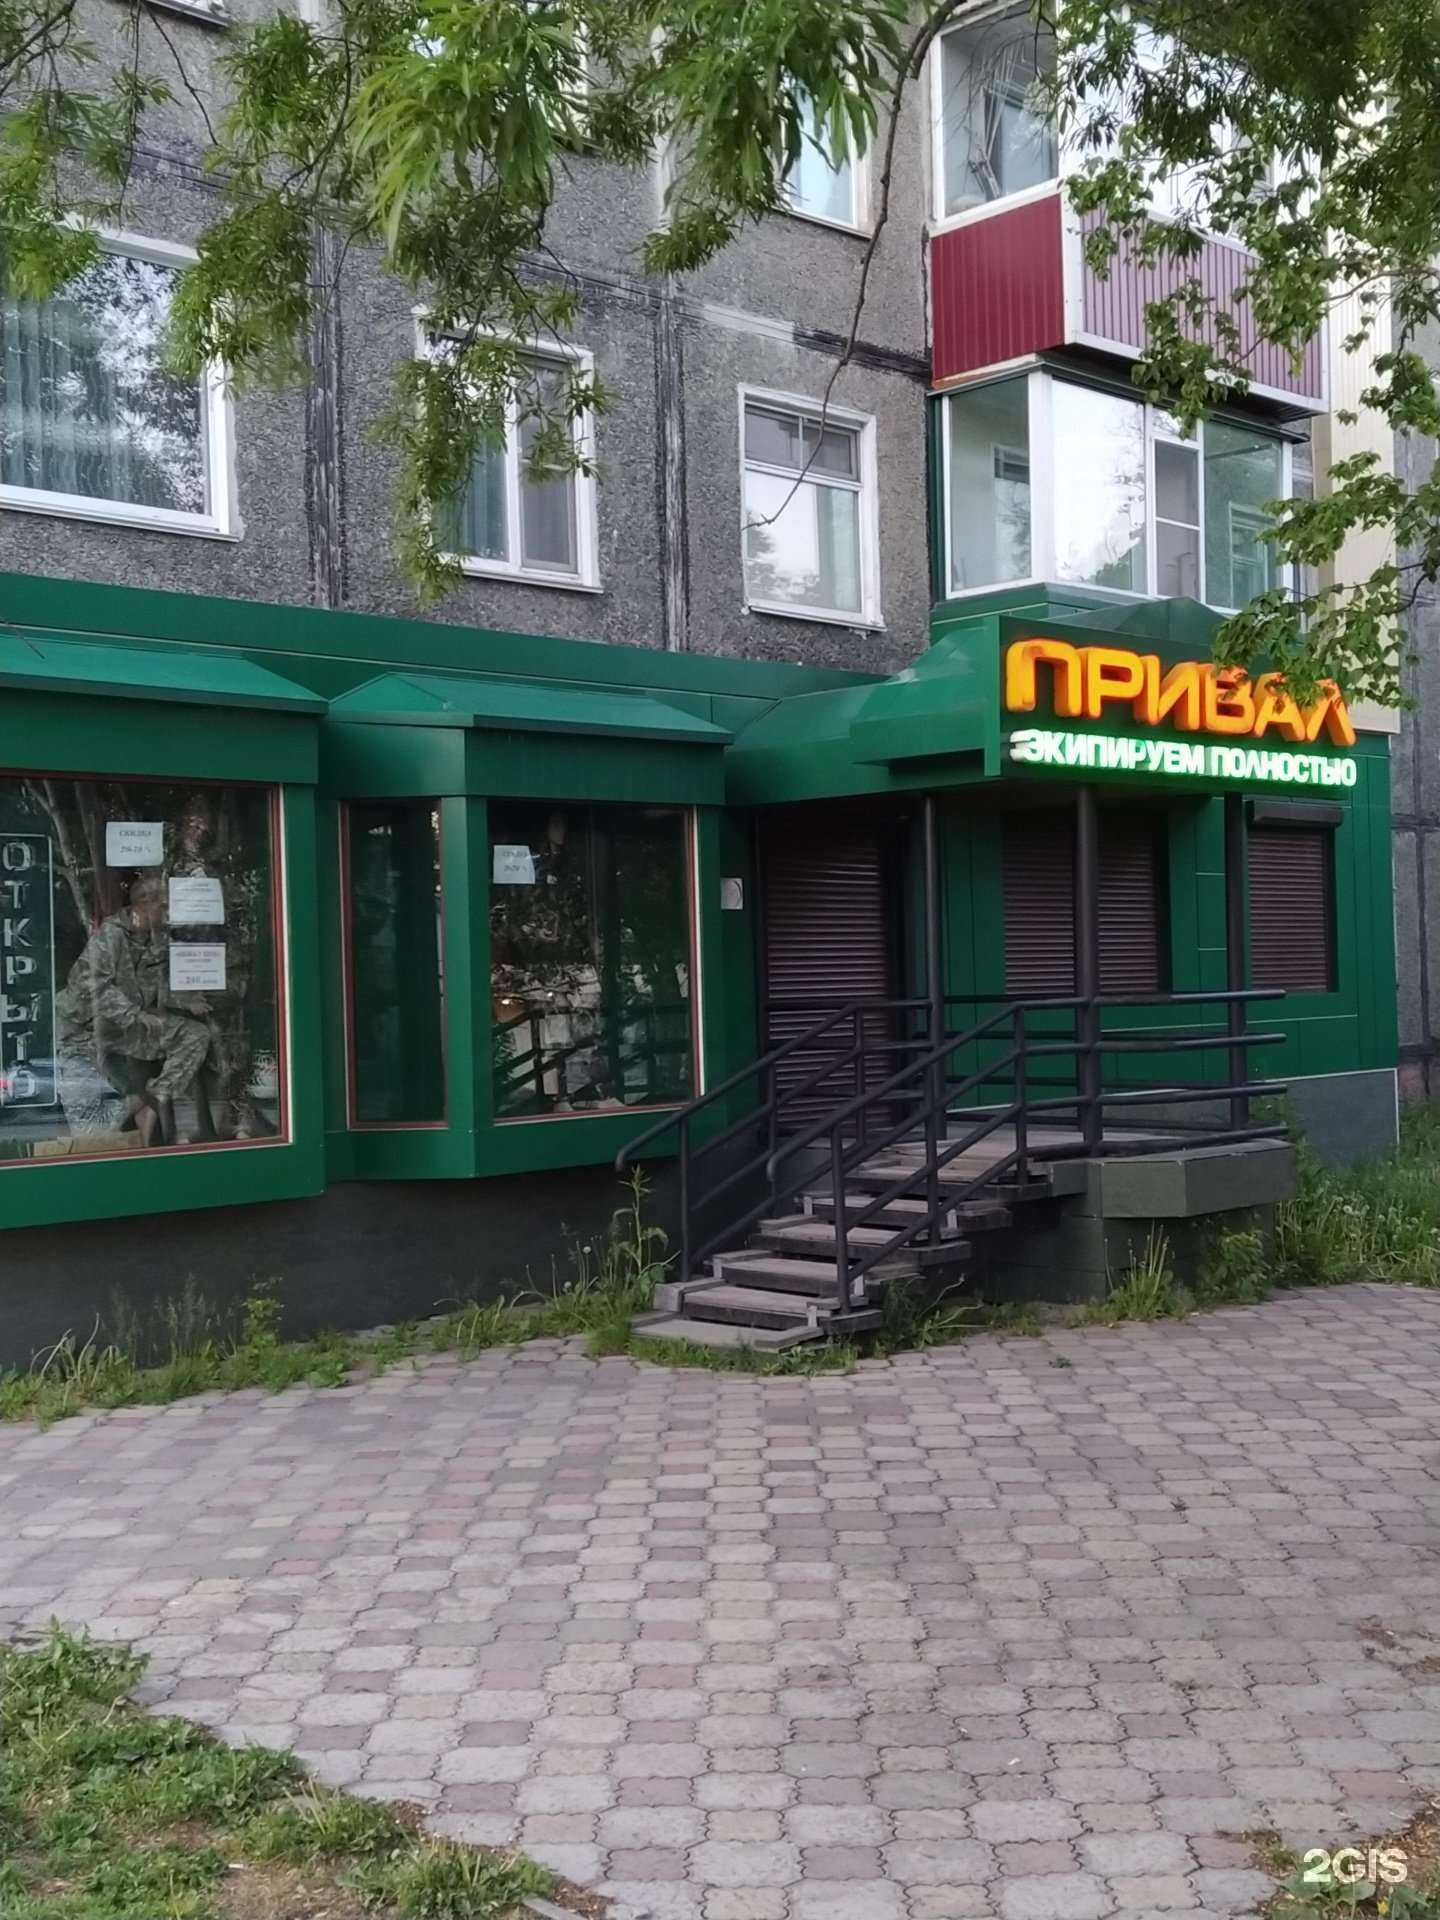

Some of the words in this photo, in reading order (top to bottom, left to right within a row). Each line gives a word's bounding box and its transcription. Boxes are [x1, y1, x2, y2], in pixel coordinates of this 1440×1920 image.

[1005, 639, 1356, 746] ПРИВАЛ
[1010, 729, 1204, 776] ЭКИПИРУЕМ
[1208, 746, 1357, 786] ПОЛНОСТЬЮ
